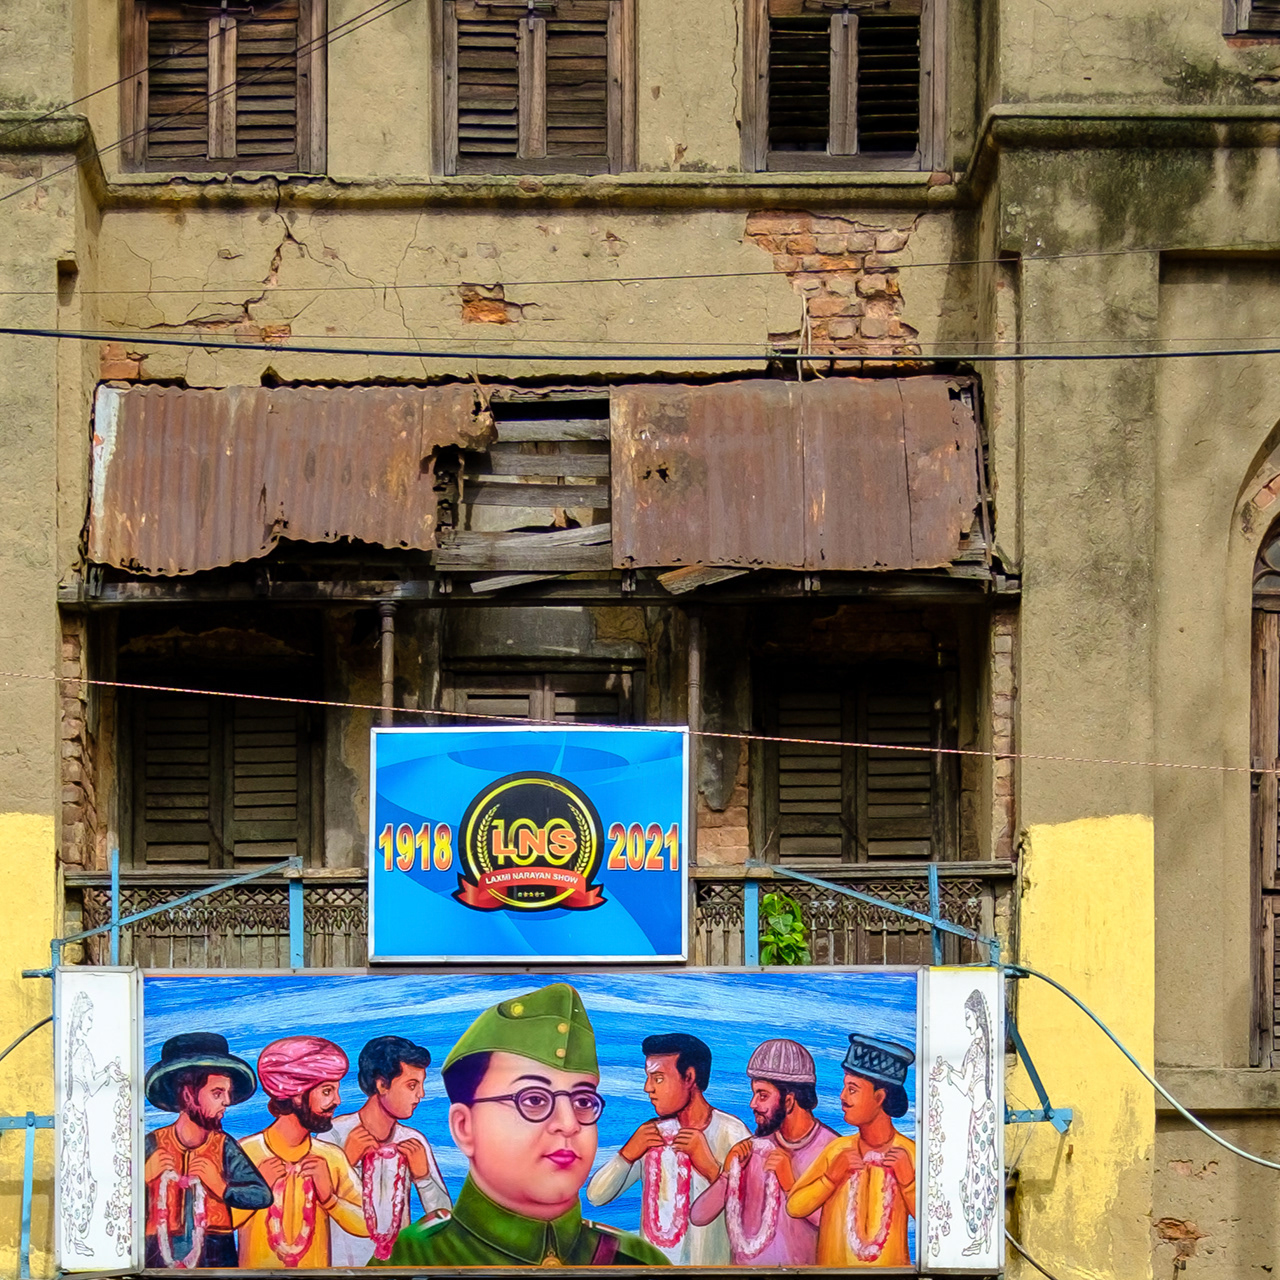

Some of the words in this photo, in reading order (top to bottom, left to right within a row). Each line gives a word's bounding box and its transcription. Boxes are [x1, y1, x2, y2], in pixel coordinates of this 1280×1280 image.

[378, 821, 453, 872] 1918
[606, 821, 681, 872] 2021
[491, 828, 578, 856] LNS
[485, 872, 511, 885] LAXMI
[512, 871, 551, 880] NARAYAN
[552, 872, 578, 884] SHOW
